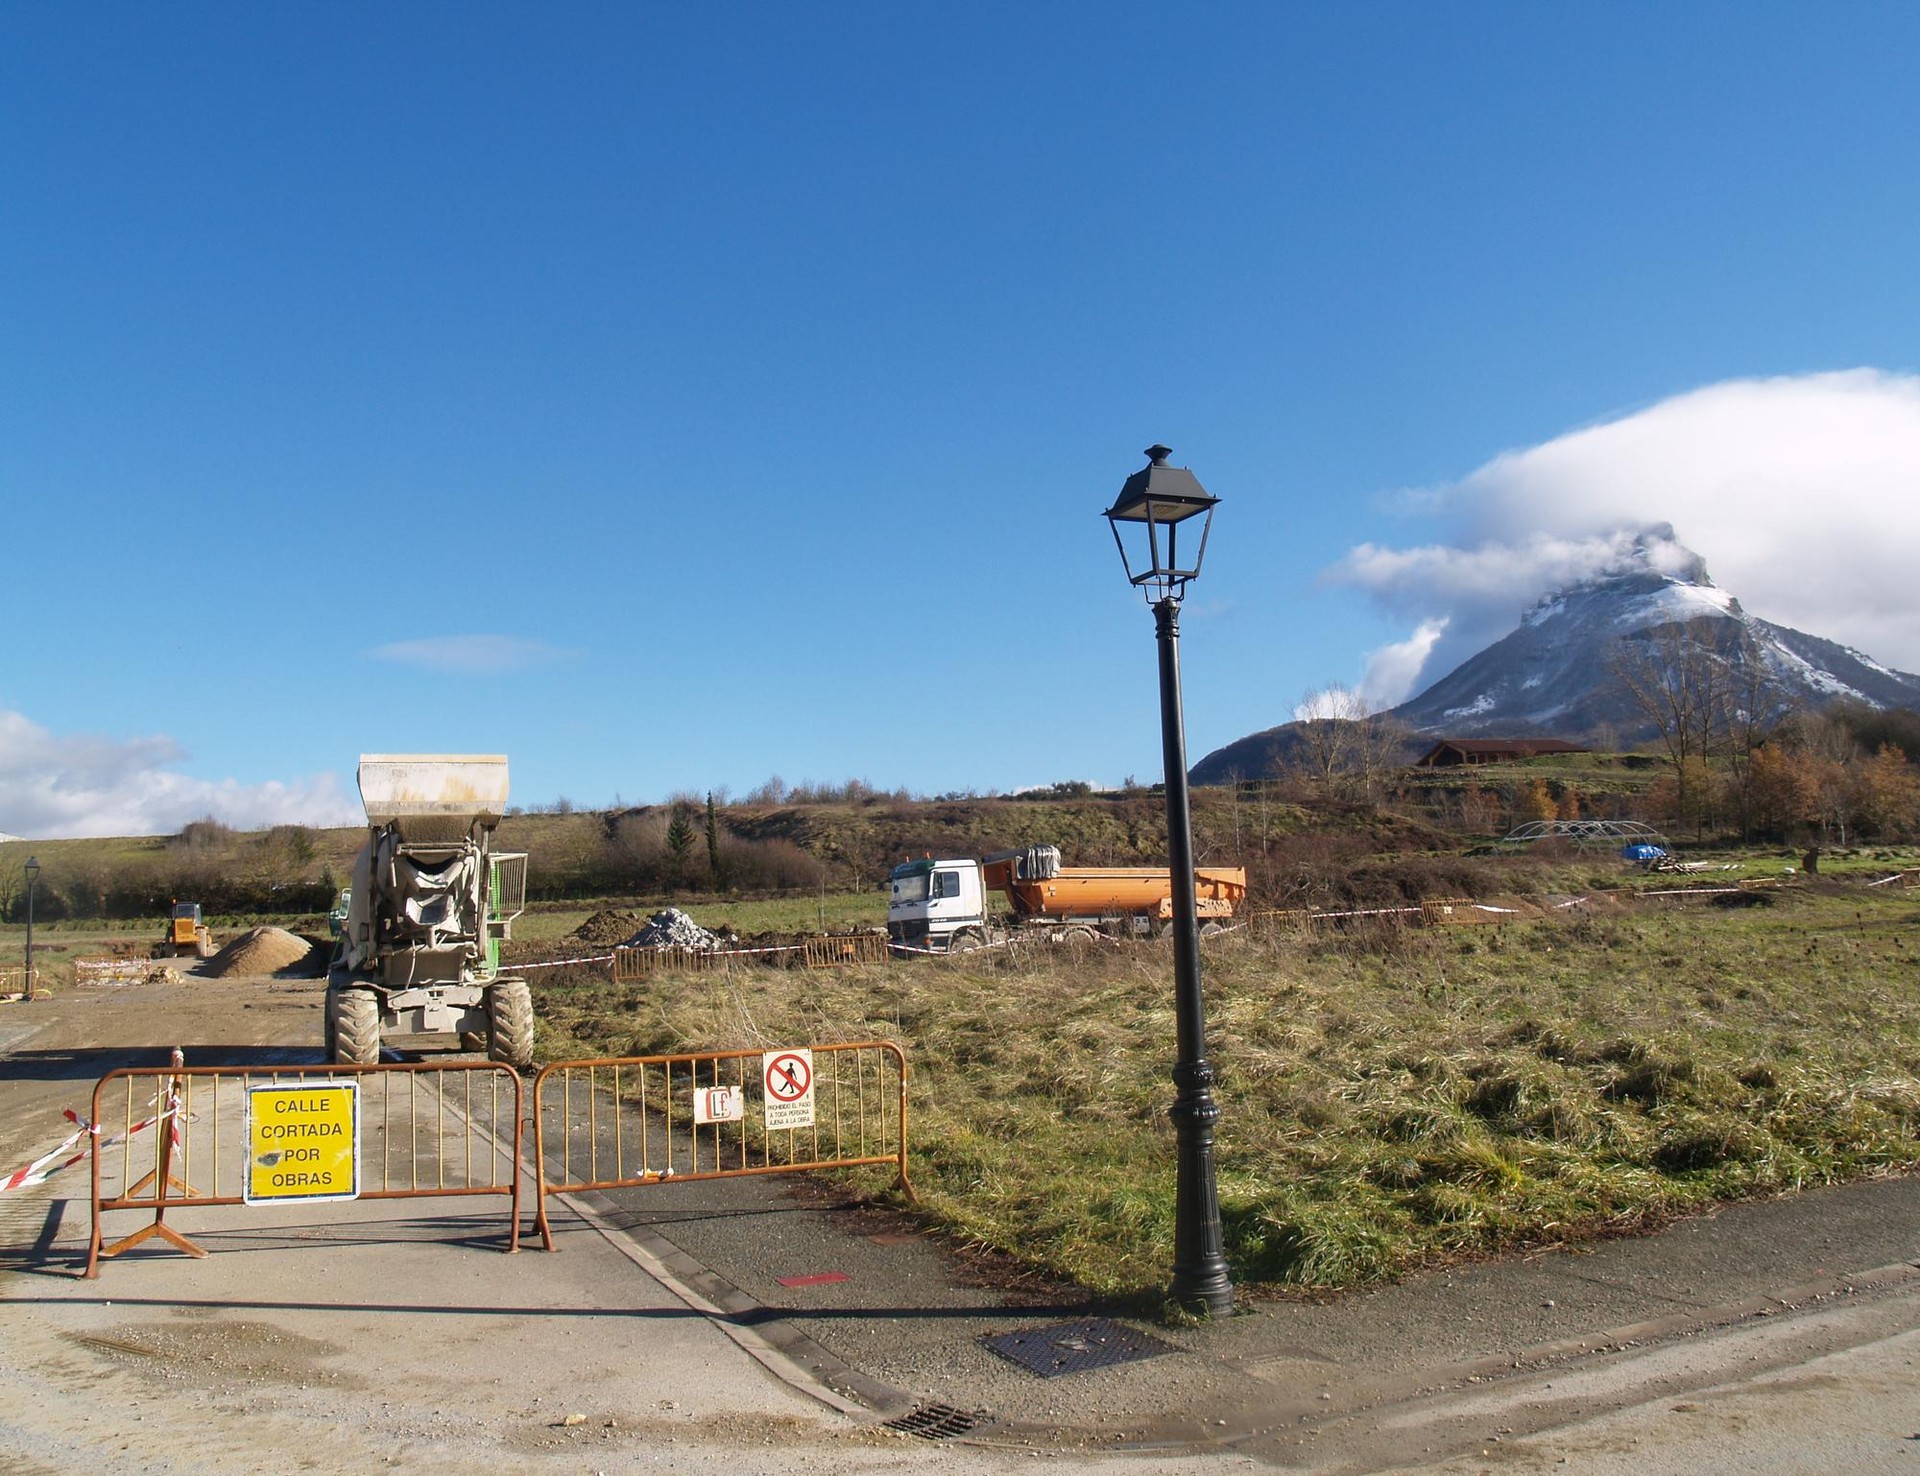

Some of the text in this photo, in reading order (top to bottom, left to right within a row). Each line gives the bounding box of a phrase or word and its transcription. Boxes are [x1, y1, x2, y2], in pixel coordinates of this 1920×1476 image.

[275, 1099, 330, 1113] CALLE
[261, 1123, 342, 1138] CORTADA
[285, 1149, 320, 1161] POR
[272, 1172, 332, 1187] OBRAS
